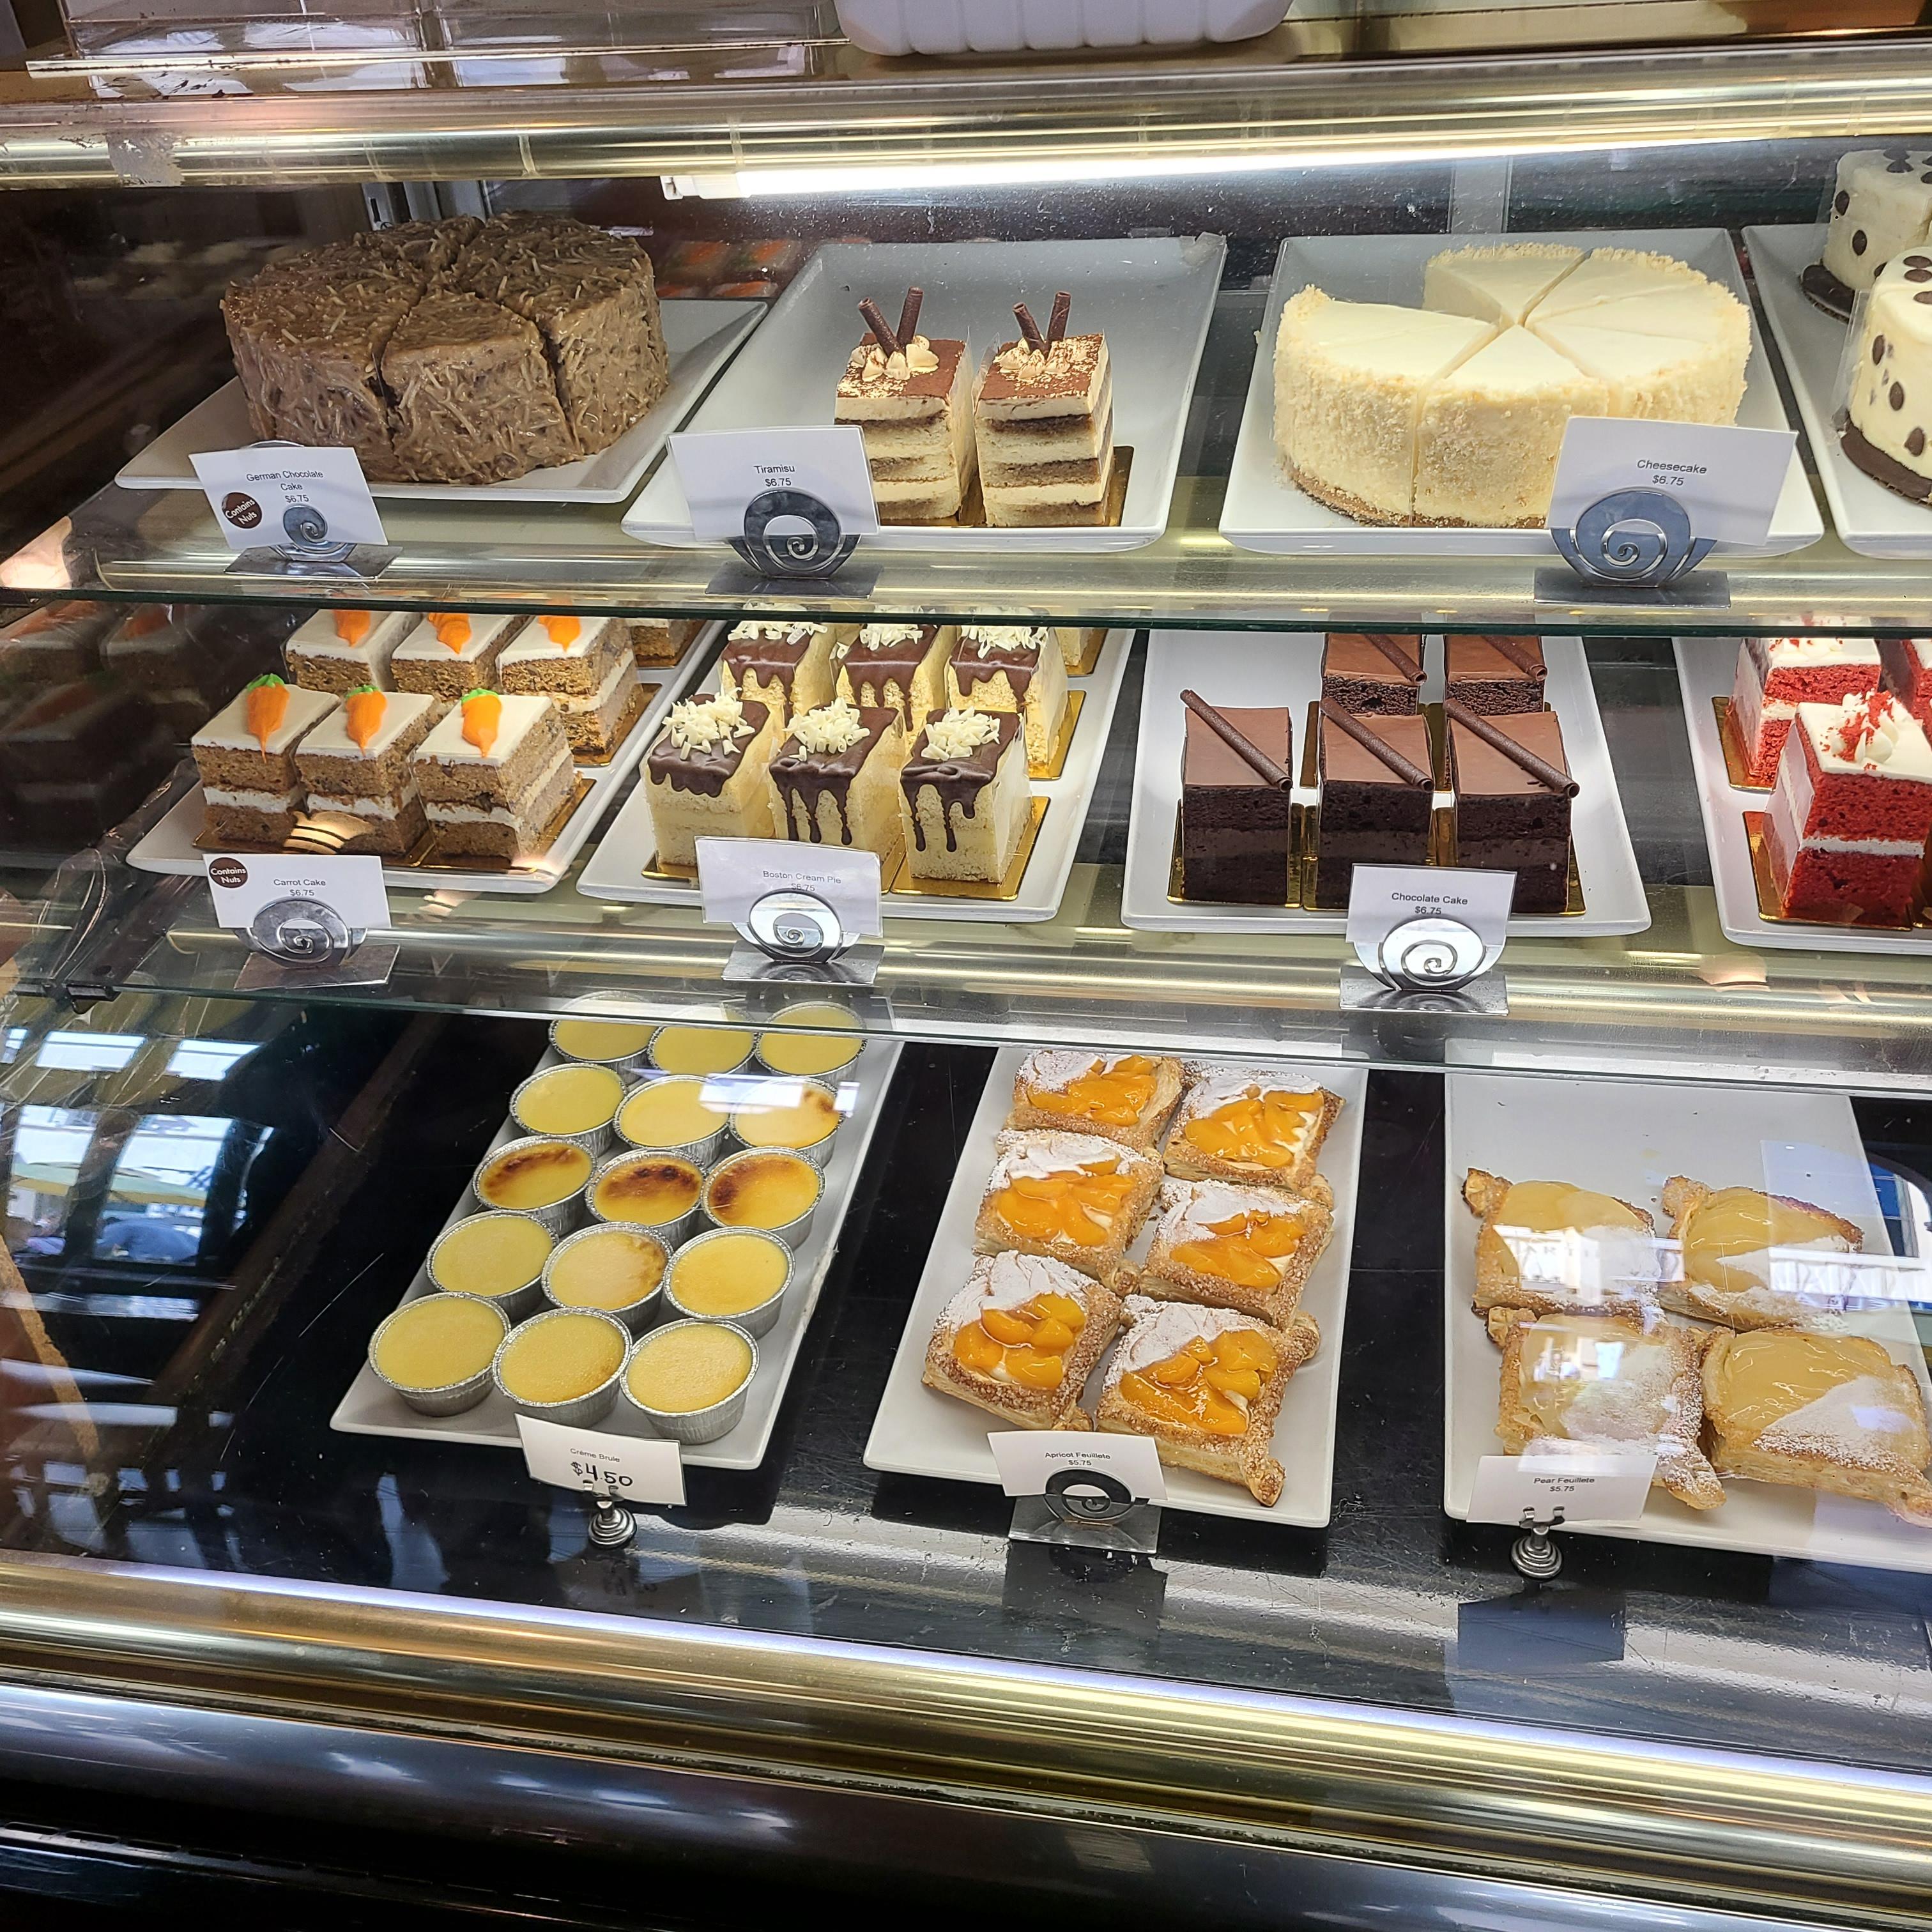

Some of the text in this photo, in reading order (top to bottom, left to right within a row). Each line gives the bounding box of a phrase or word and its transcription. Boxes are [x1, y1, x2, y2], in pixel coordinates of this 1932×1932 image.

[754, 464, 795, 473] Tiramisu
[1637, 459, 1707, 474] Cheesecake
[246, 470, 323, 482] German Chocolate
[1652, 475, 1684, 486] $6.75
[765, 478, 792, 487] $6.75
[285, 494, 309, 503] $6.75
[225, 498, 255, 519] Contains
[238, 512, 257, 525] Nuts
[210, 867, 247, 876] Contains
[763, 870, 841, 884] Boston Cream Pie
[791, 883, 815, 891] $6.75
[1392, 893, 1468, 905] Chocolate Cake
[1414, 906, 1441, 915] $6.75
[599, 1453, 620, 1462] Brule
[571, 1461, 633, 1487] $4.50
